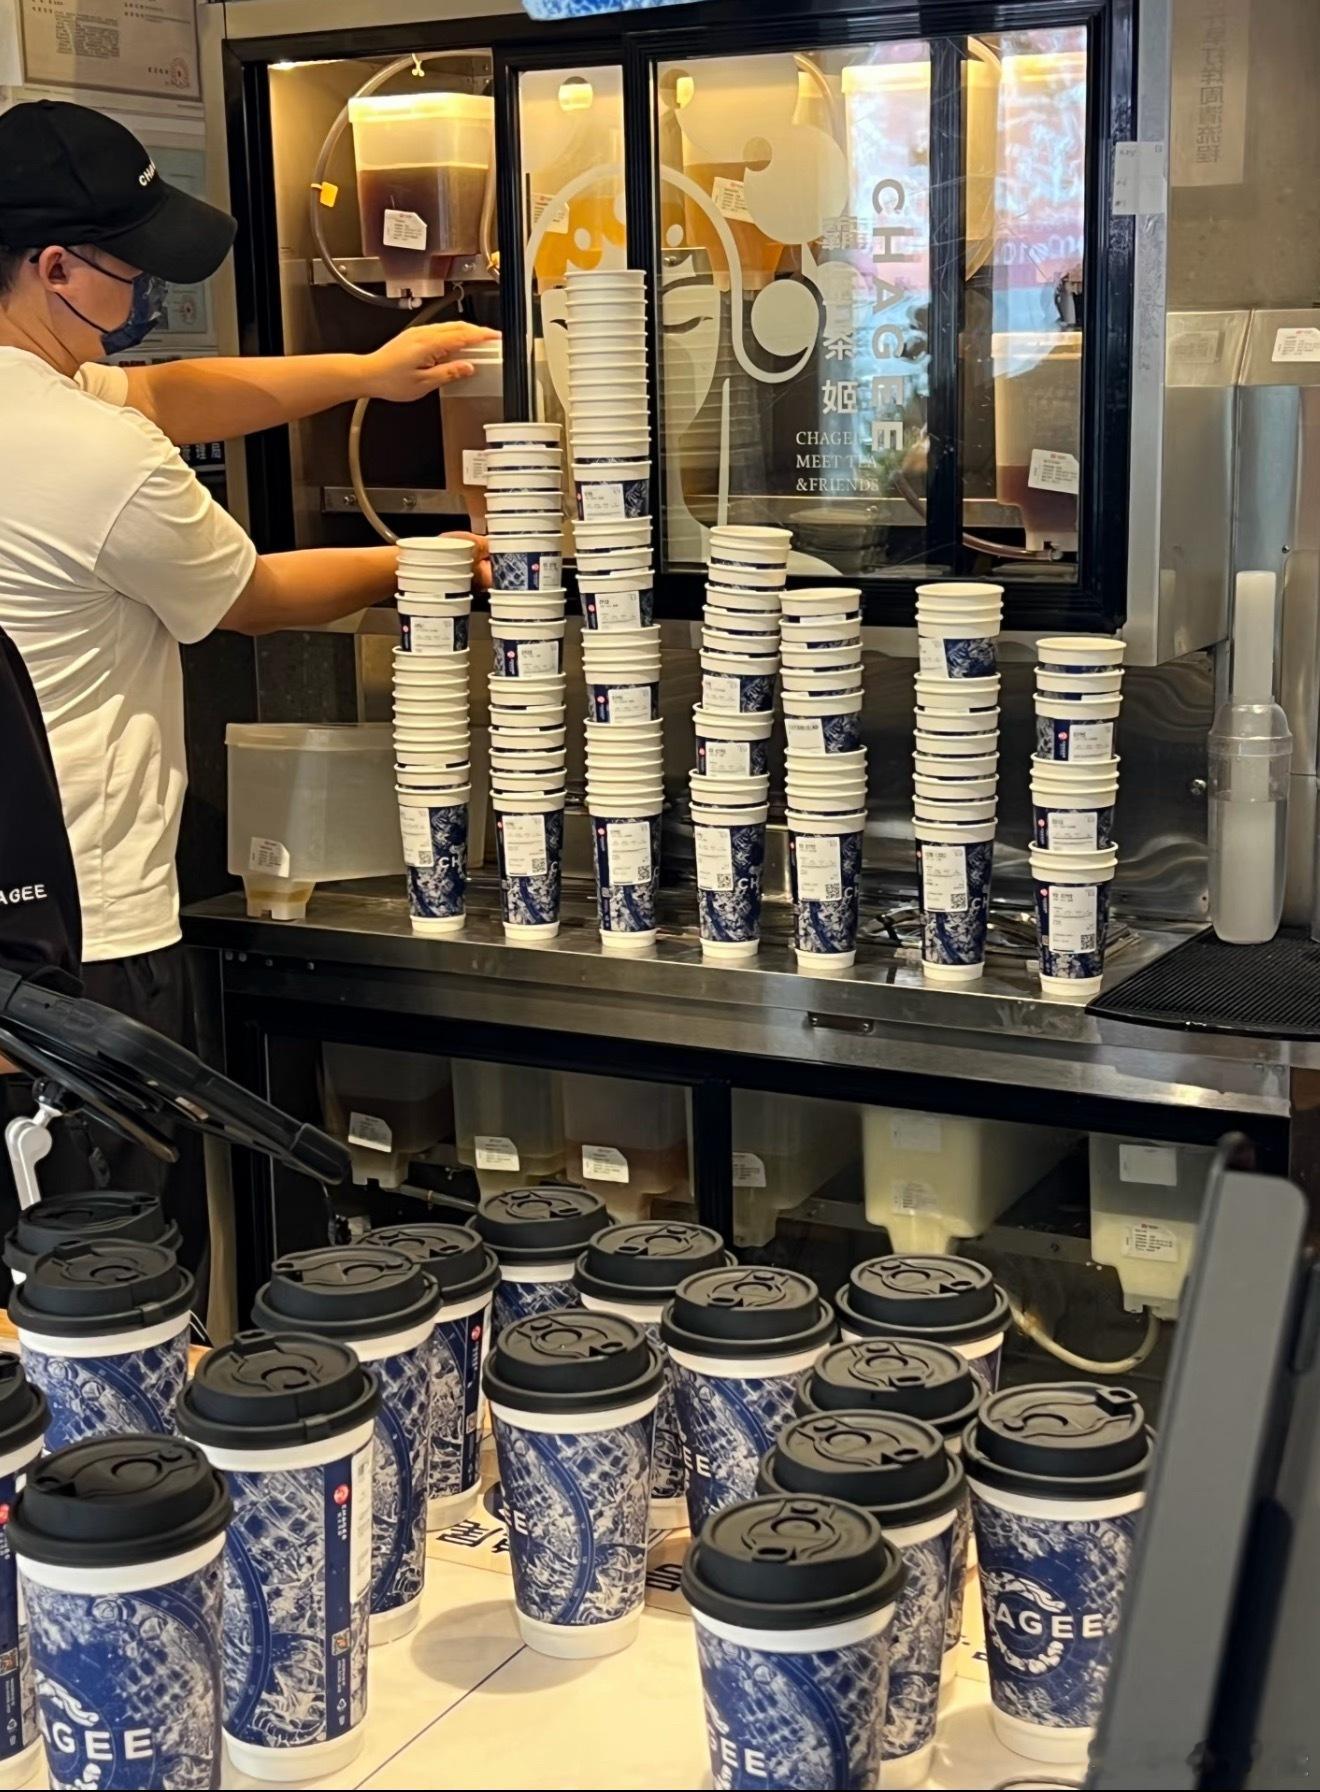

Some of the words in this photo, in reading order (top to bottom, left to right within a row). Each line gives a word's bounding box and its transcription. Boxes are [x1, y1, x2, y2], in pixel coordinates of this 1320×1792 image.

[821, 215, 858, 415] 霸茶姬
[872, 178, 906, 451] CHAGEE
[796, 455, 842, 468] MEET
[796, 477, 879, 492] &FRIENDS
[995, 1602, 1104, 1639] AGEE
